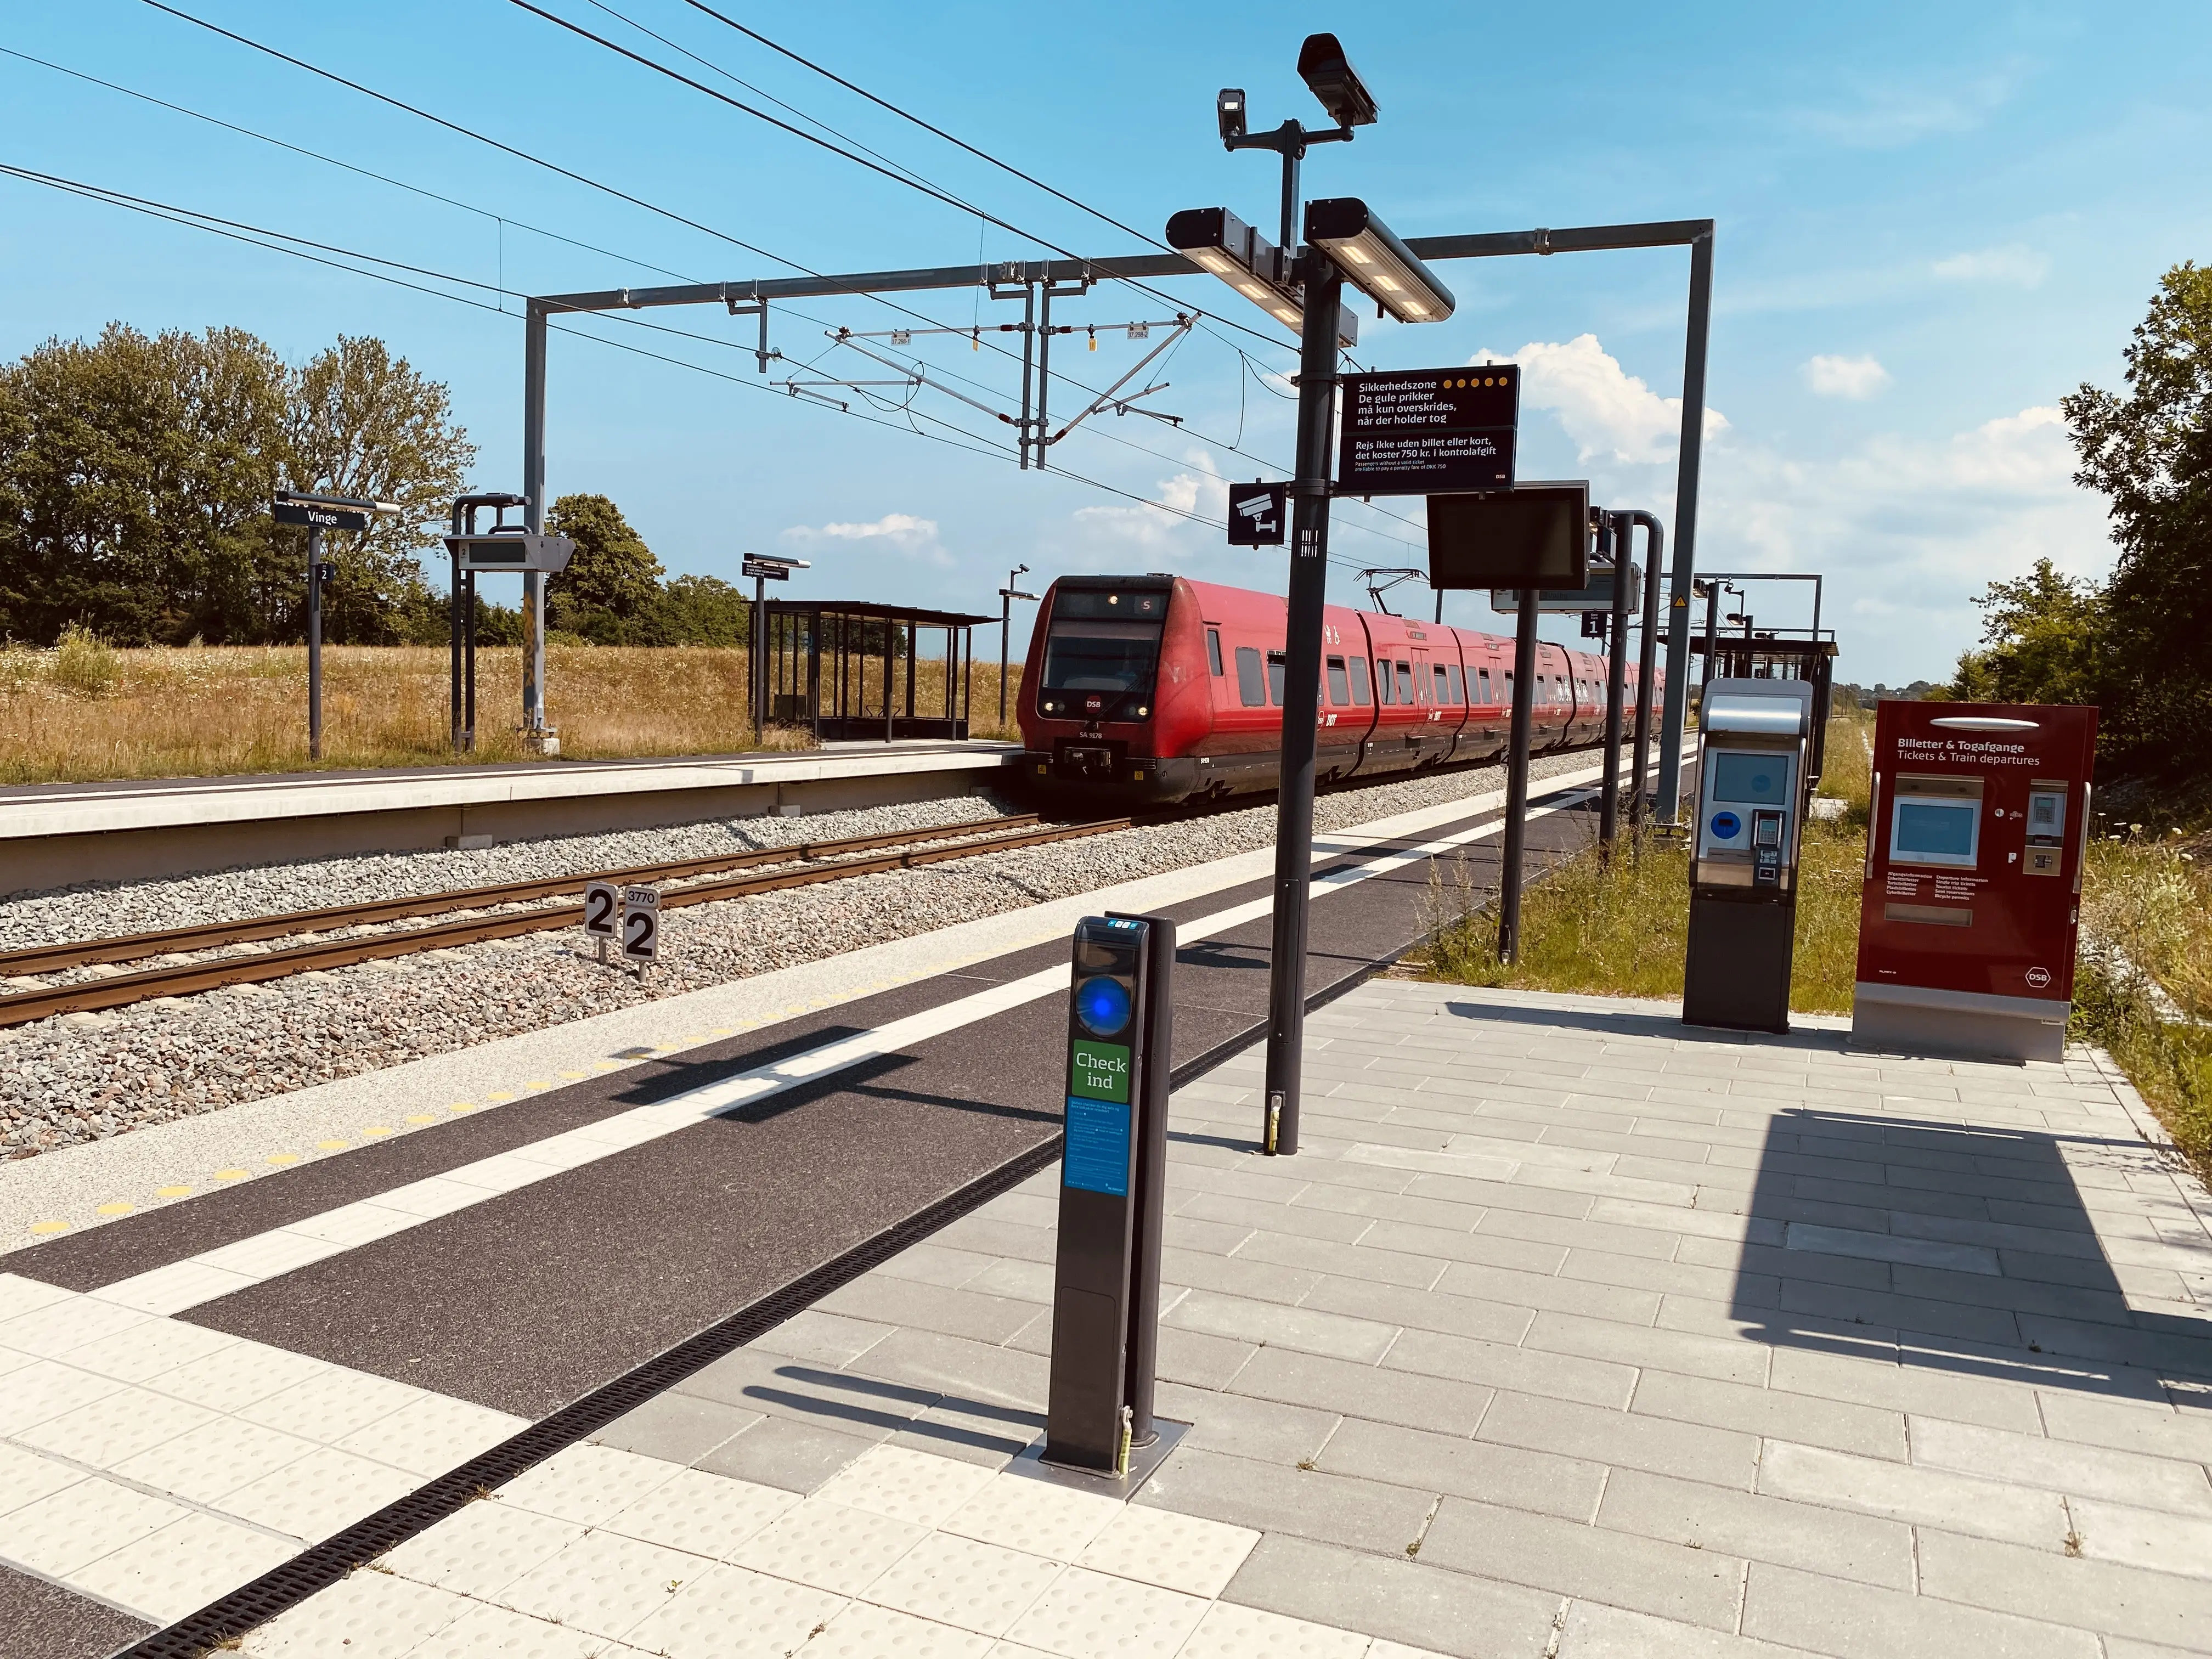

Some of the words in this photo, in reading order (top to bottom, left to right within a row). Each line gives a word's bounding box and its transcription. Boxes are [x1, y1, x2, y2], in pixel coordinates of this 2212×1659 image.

[1359, 381, 1437, 392] Sikkerhedszone
[1358, 394, 1372, 403] De
[1375, 393, 1396, 404] gule
[1399, 392, 1435, 403] prikker
[1358, 404, 1373, 414] må
[1376, 404, 1394, 414] kun
[1397, 401, 1457, 413] overskrides,
[1357, 416, 1374, 426] når
[1375, 416, 1392, 425] der
[1394, 414, 1427, 424] holder
[1429, 414, 1447, 424] tog
[1356, 441, 1374, 450] Rejs
[1376, 440, 1395, 449] ikke
[1397, 439, 1419, 448] uden
[1422, 438, 1445, 447] billet
[1447, 437, 1468, 446] eller
[1470, 437, 1491, 445] kort,
[1356, 452, 1370, 460] det
[1372, 450, 1400, 459] koster
[1401, 449, 1418, 458] 750
[1420, 449, 1431, 457] kr.
[1439, 446, 1497, 456] kontrolafgift
[308, 511, 338, 527] Vinge
[321, 569, 327, 579] 2
[1143, 601, 1150, 610] S
[1589, 620, 1598, 634] 1
[1898, 738, 1944, 749] Billetter
[1946, 740, 1955, 750] &
[1957, 741, 2025, 753] Togafgange
[1897, 750, 1935, 761] Tickets
[1938, 752, 1946, 761] &
[1950, 752, 1976, 763] Train
[1979, 753, 2040, 766] departures
[628, 890, 655, 904] 3770
[588, 888, 613, 933] 2
[627, 912, 654, 957] 2
[2029, 973, 2047, 982] DSB
[1076, 1052, 1126, 1074] Check
[1087, 1073, 1113, 1090] ind
